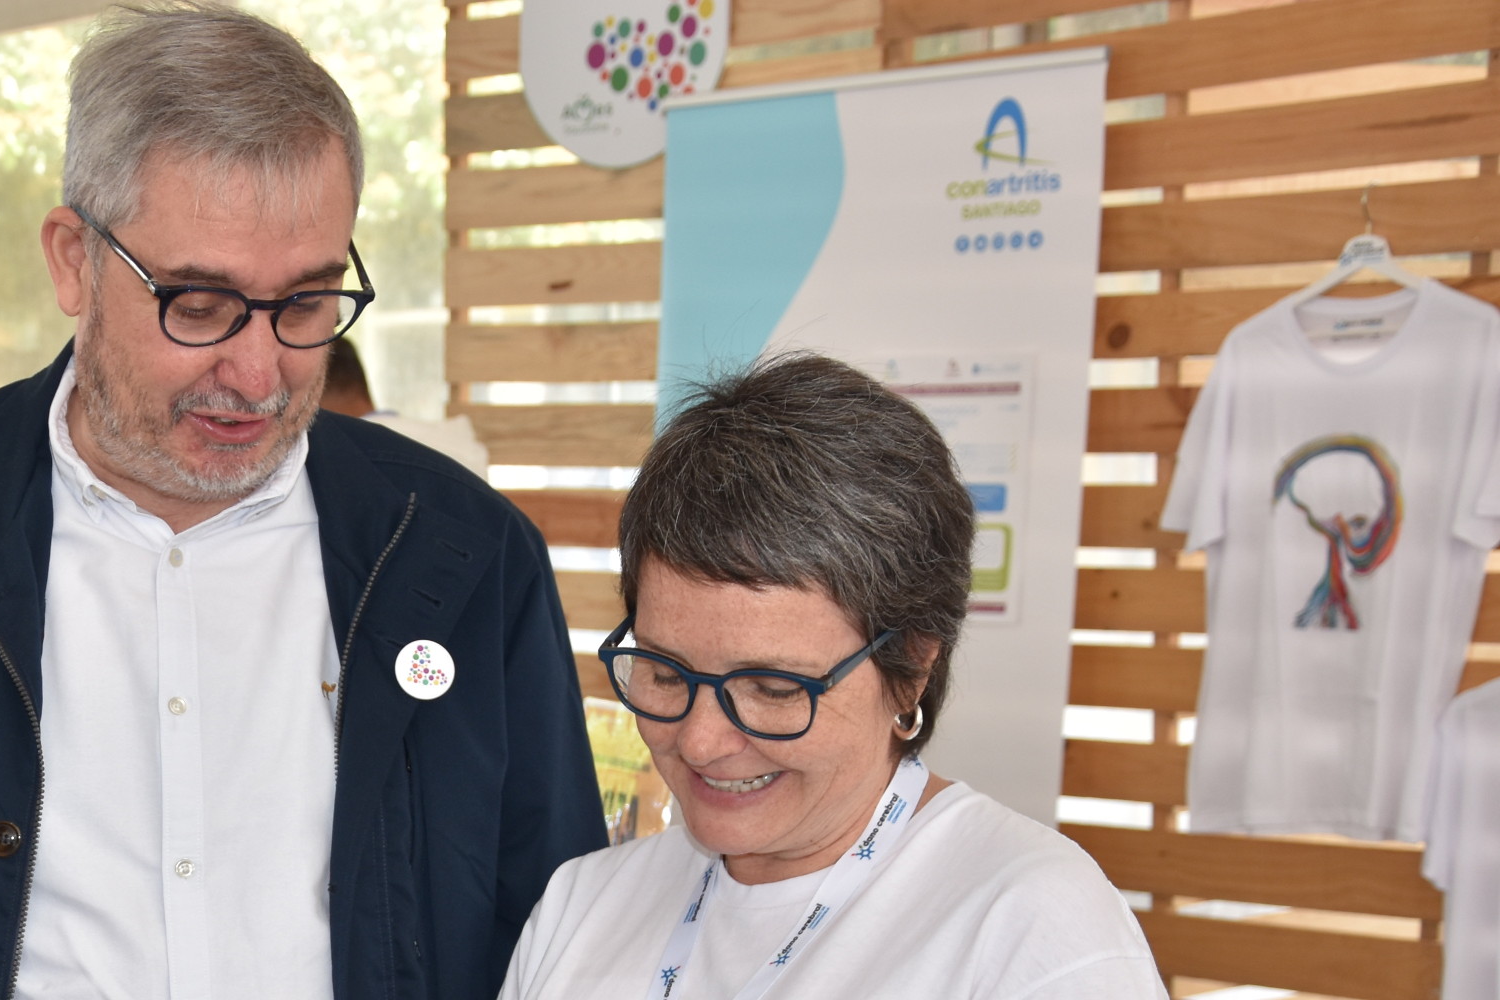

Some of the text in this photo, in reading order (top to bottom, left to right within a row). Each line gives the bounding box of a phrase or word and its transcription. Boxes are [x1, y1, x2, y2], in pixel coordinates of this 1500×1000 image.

[946, 170, 1061, 199] conartritis
[961, 199, 1043, 221] SANTIAGO
[877, 792, 900, 827] cerebral
[797, 903, 822, 935] cerebral
